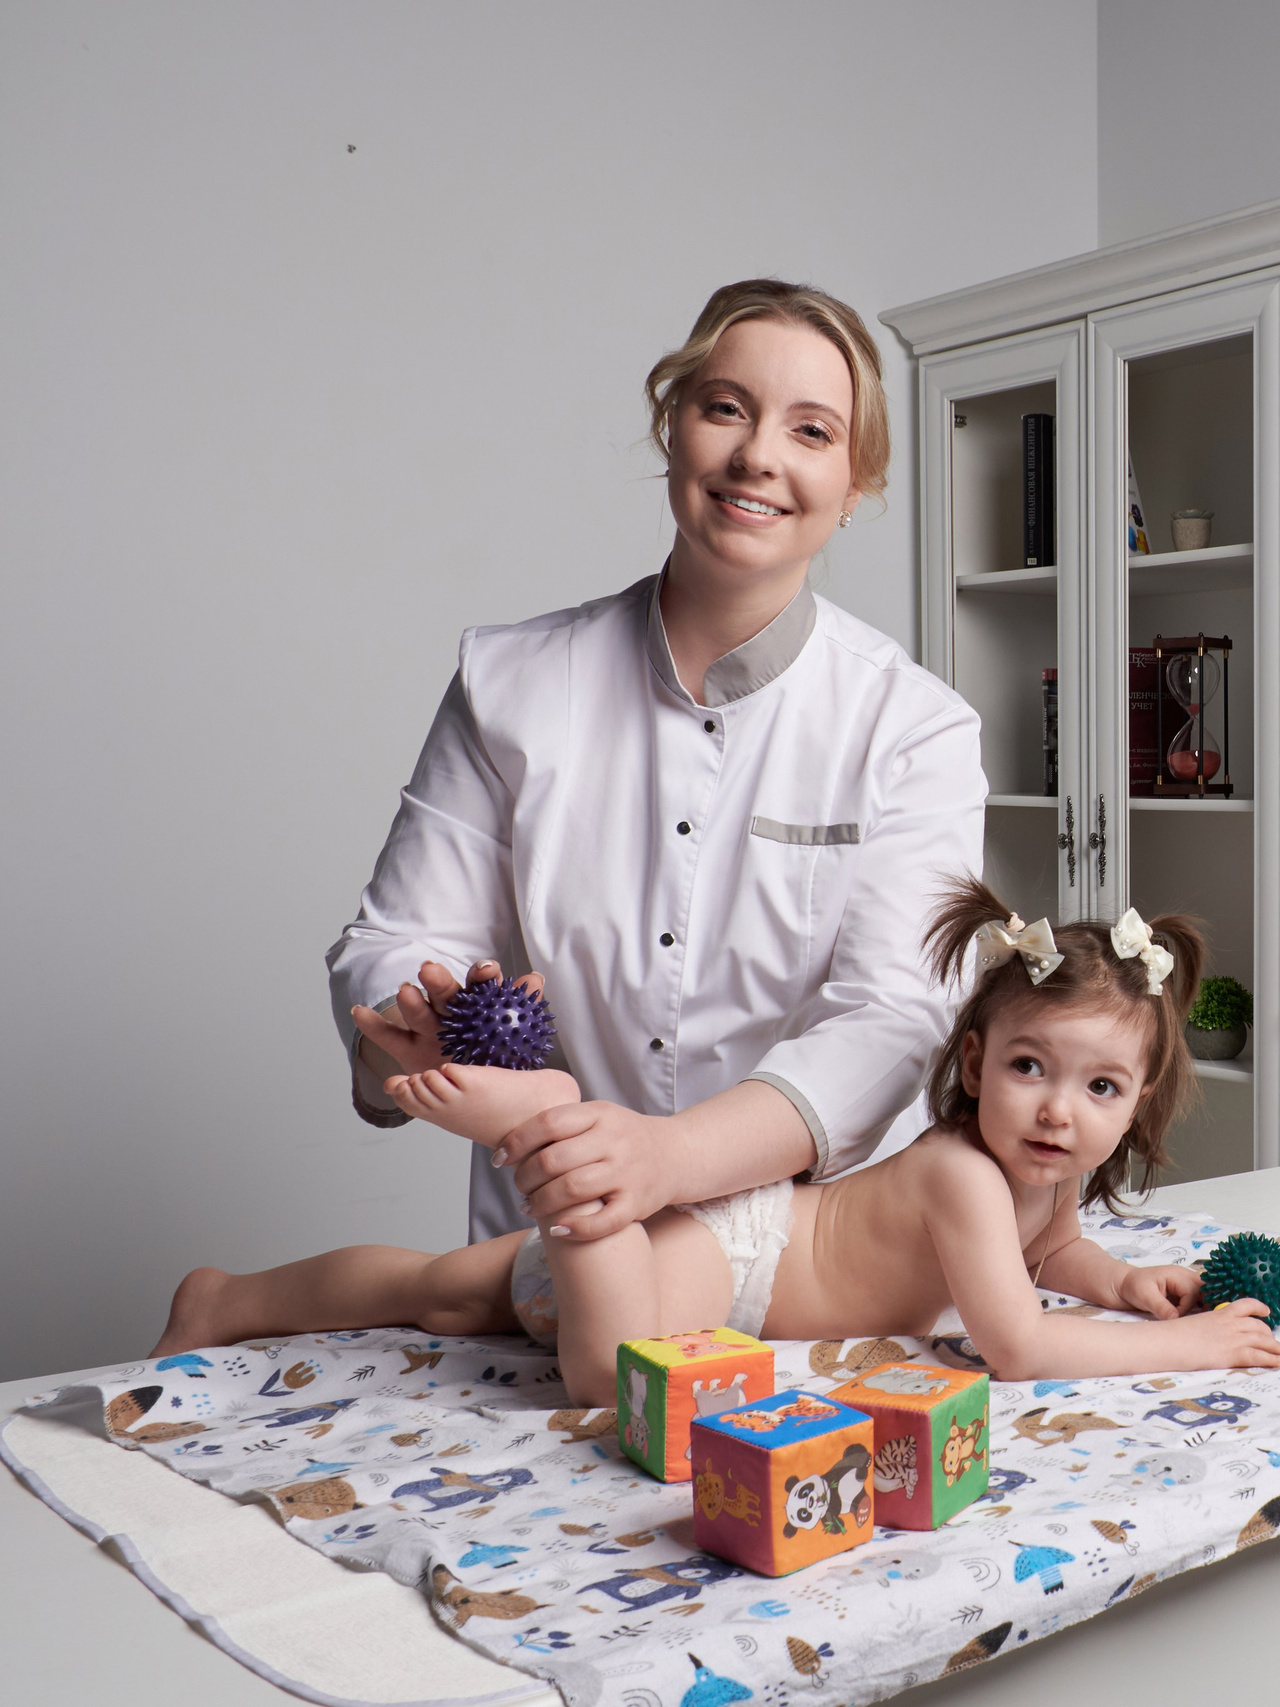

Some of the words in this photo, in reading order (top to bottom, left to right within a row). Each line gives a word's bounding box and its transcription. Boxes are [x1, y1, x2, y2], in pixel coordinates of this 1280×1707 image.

[1027, 418, 1036, 470] ИНЖЕНЕРИЯ
[1027, 471, 1036, 527] ФИНАНСОВАЯ
[1131, 702, 1154, 710] УЧЕТ
